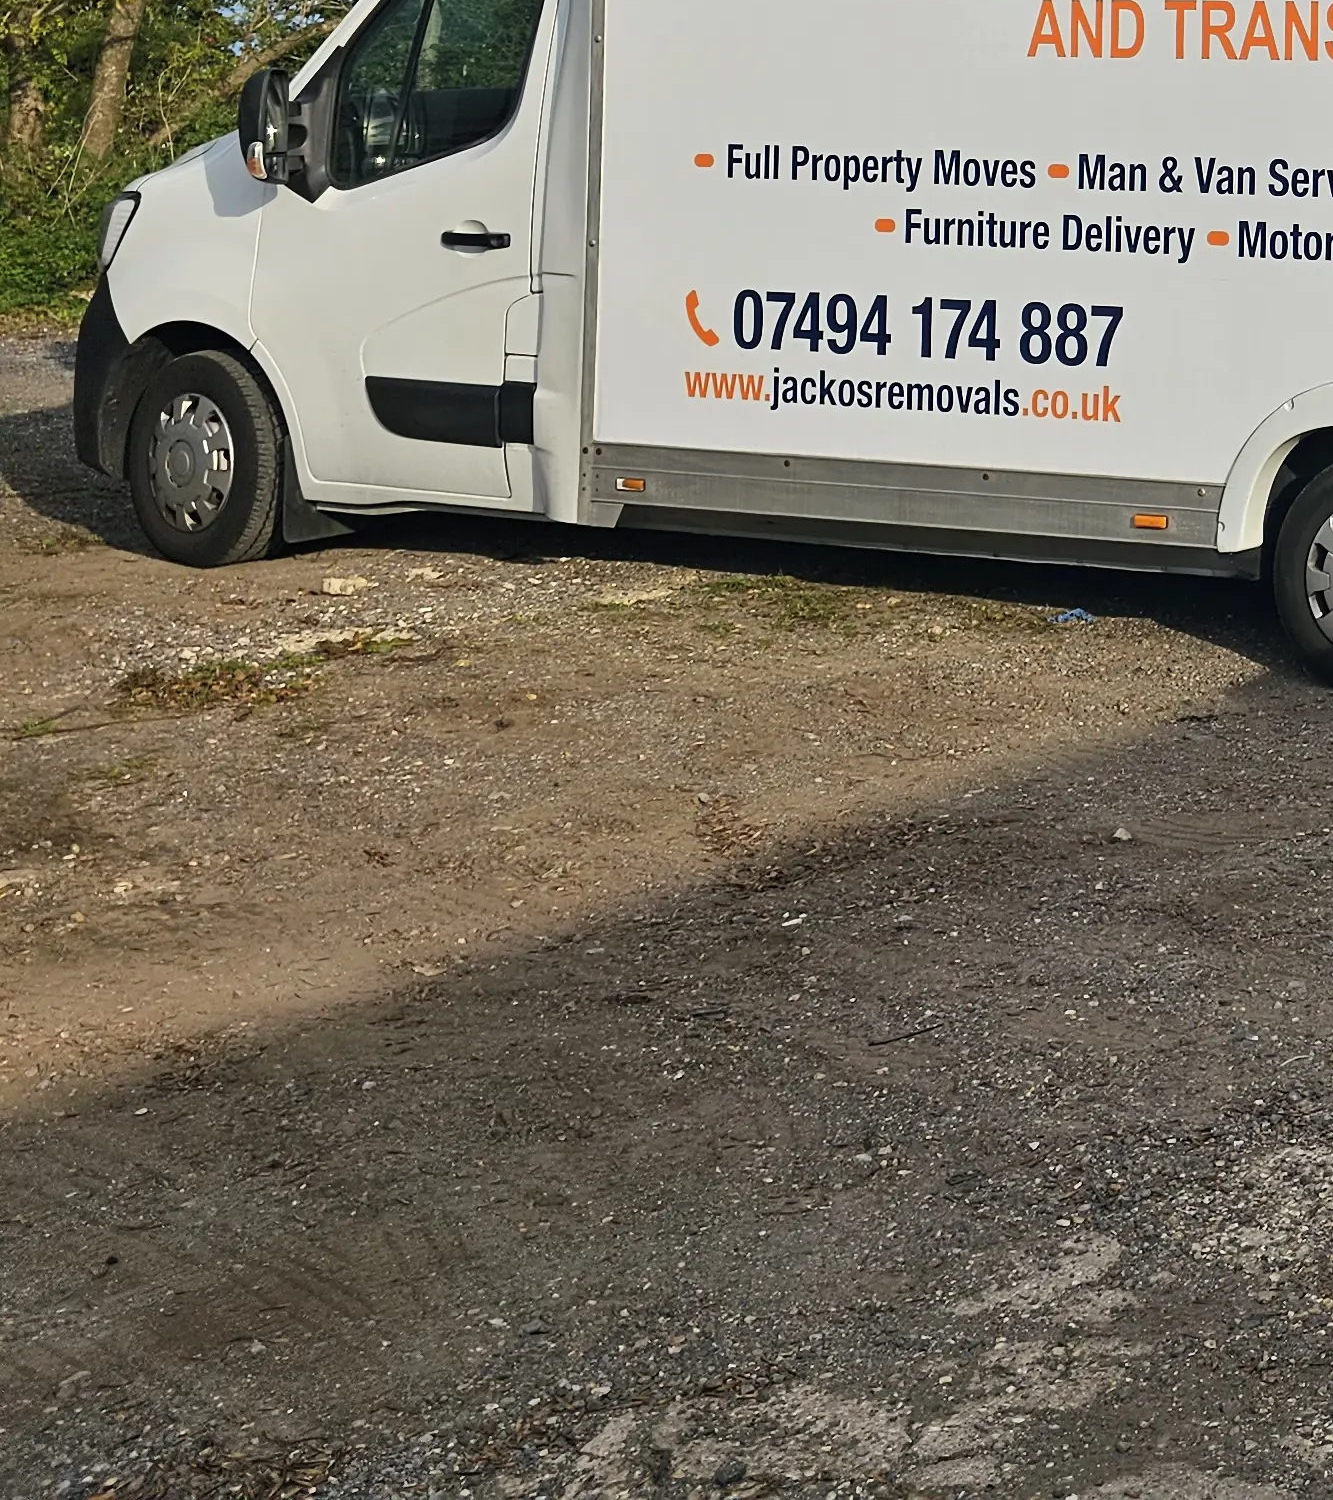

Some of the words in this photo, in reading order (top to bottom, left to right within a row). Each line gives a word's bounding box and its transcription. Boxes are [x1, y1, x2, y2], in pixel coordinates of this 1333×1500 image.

[727, 143, 780, 180] Full
[791, 145, 923, 193] Property
[933, 149, 1036, 189] Moves
[1078, 153, 1147, 192] Man
[1158, 156, 1183, 193] &
[1194, 156, 1256, 196] Van
[905, 208, 1050, 250] Furniture
[1062, 214, 1196, 264] Delivery
[733, 289, 892, 356] 07494
[911, 296, 1001, 362] 174
[1019, 301, 1124, 368] 887
[685, 366, 1121, 422] www.jackosremovals.co.uk
